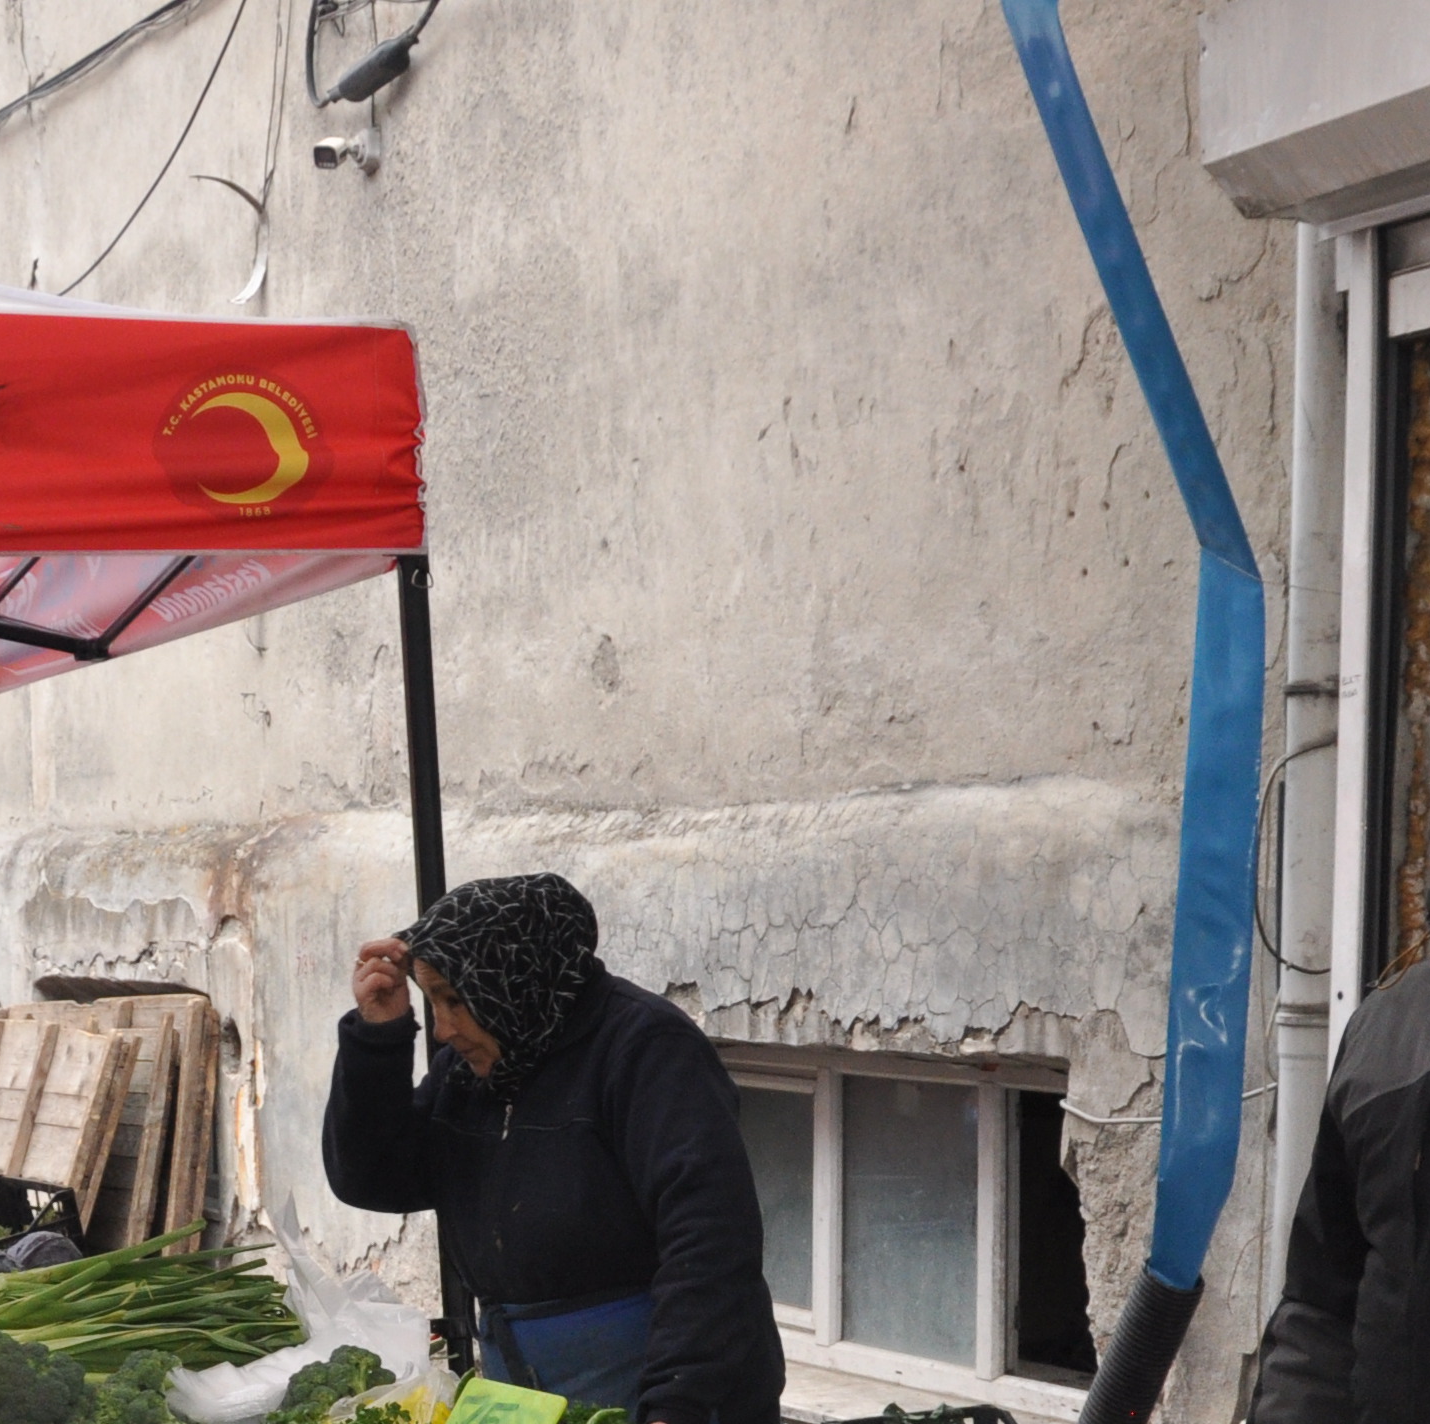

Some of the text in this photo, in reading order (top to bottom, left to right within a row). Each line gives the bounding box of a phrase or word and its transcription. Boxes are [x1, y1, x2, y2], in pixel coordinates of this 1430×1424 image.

[162, 374, 319, 440] T.C. KASTAMONU BELEDİYESİ
